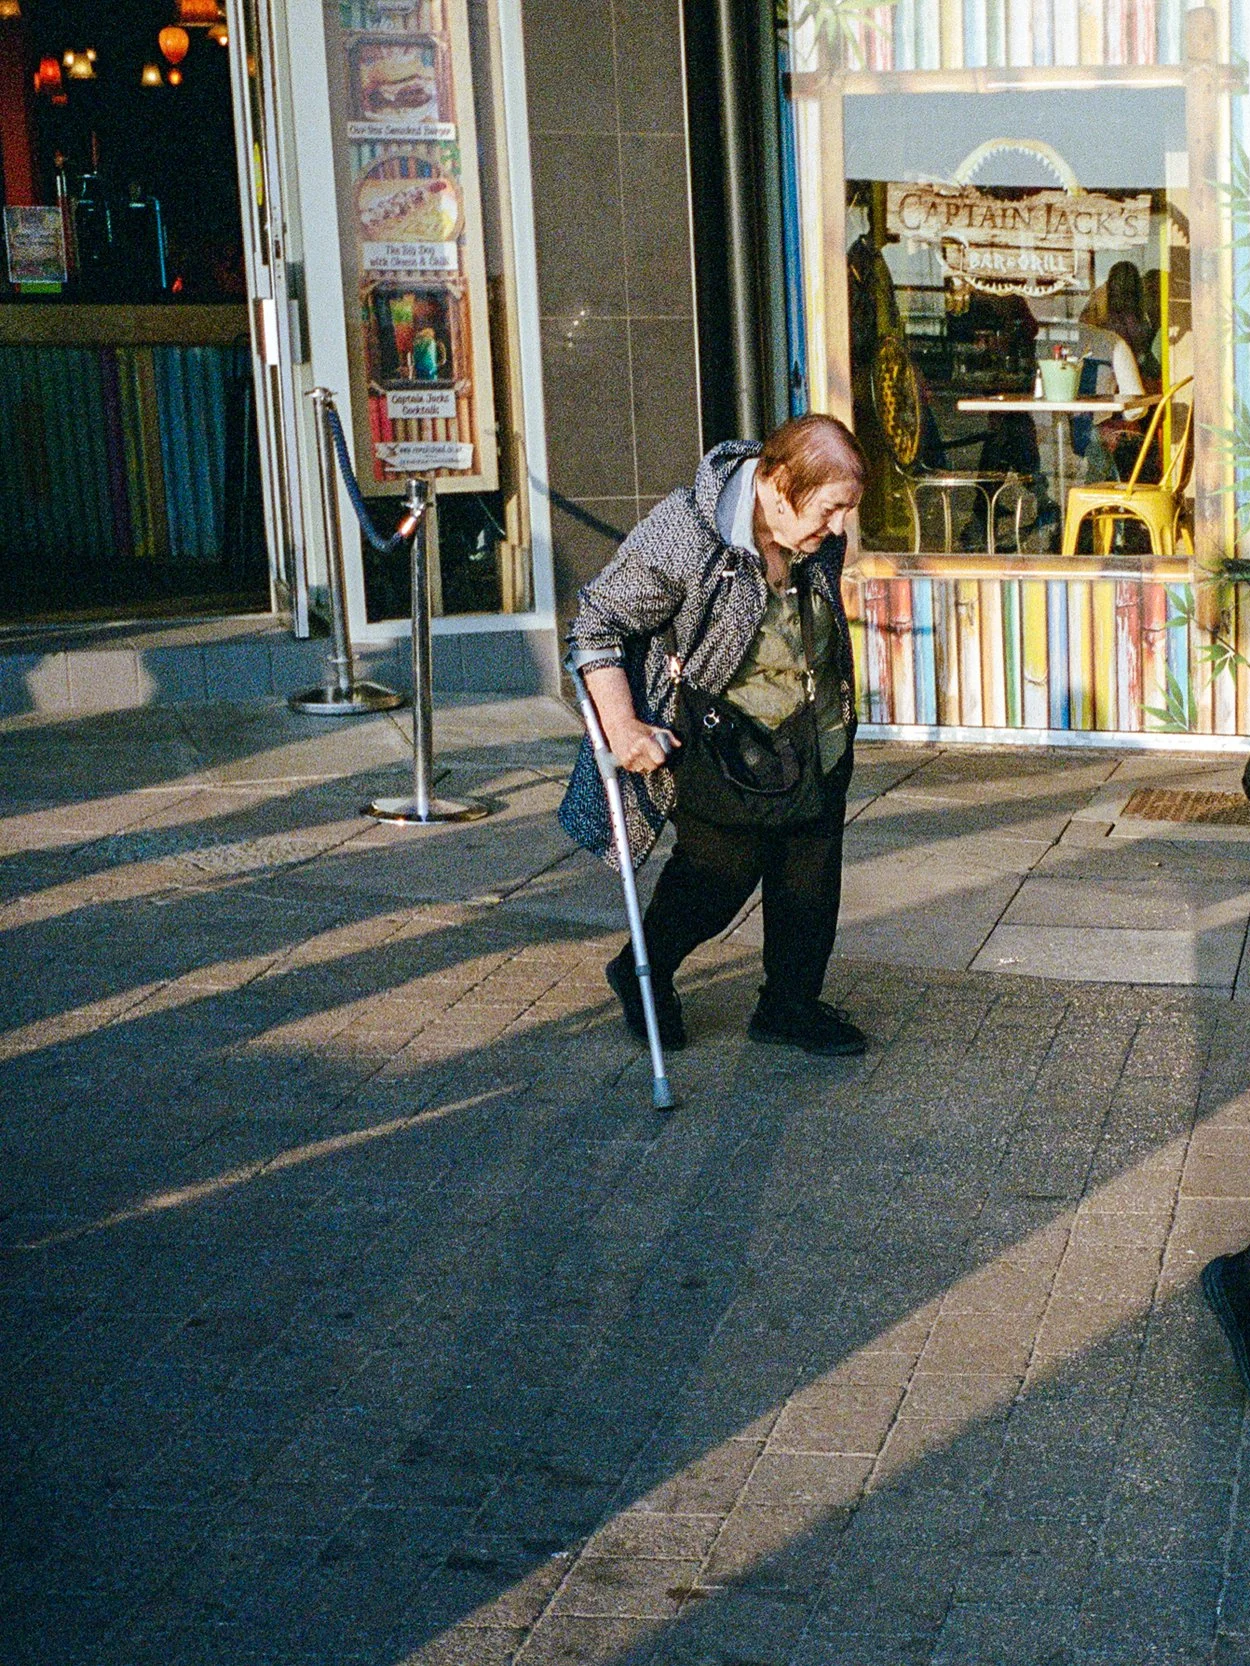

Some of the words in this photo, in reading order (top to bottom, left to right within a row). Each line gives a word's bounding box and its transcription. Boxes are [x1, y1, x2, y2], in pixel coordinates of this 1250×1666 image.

[899, 193, 1032, 231] CAPTAIN
[1040, 203, 1140, 240] JACK'S
[968, 250, 1007, 274] BAR
[1018, 250, 1068, 276] GRILL
[391, 394, 424, 405] Captain
[402, 405, 440, 415] Cocktails
